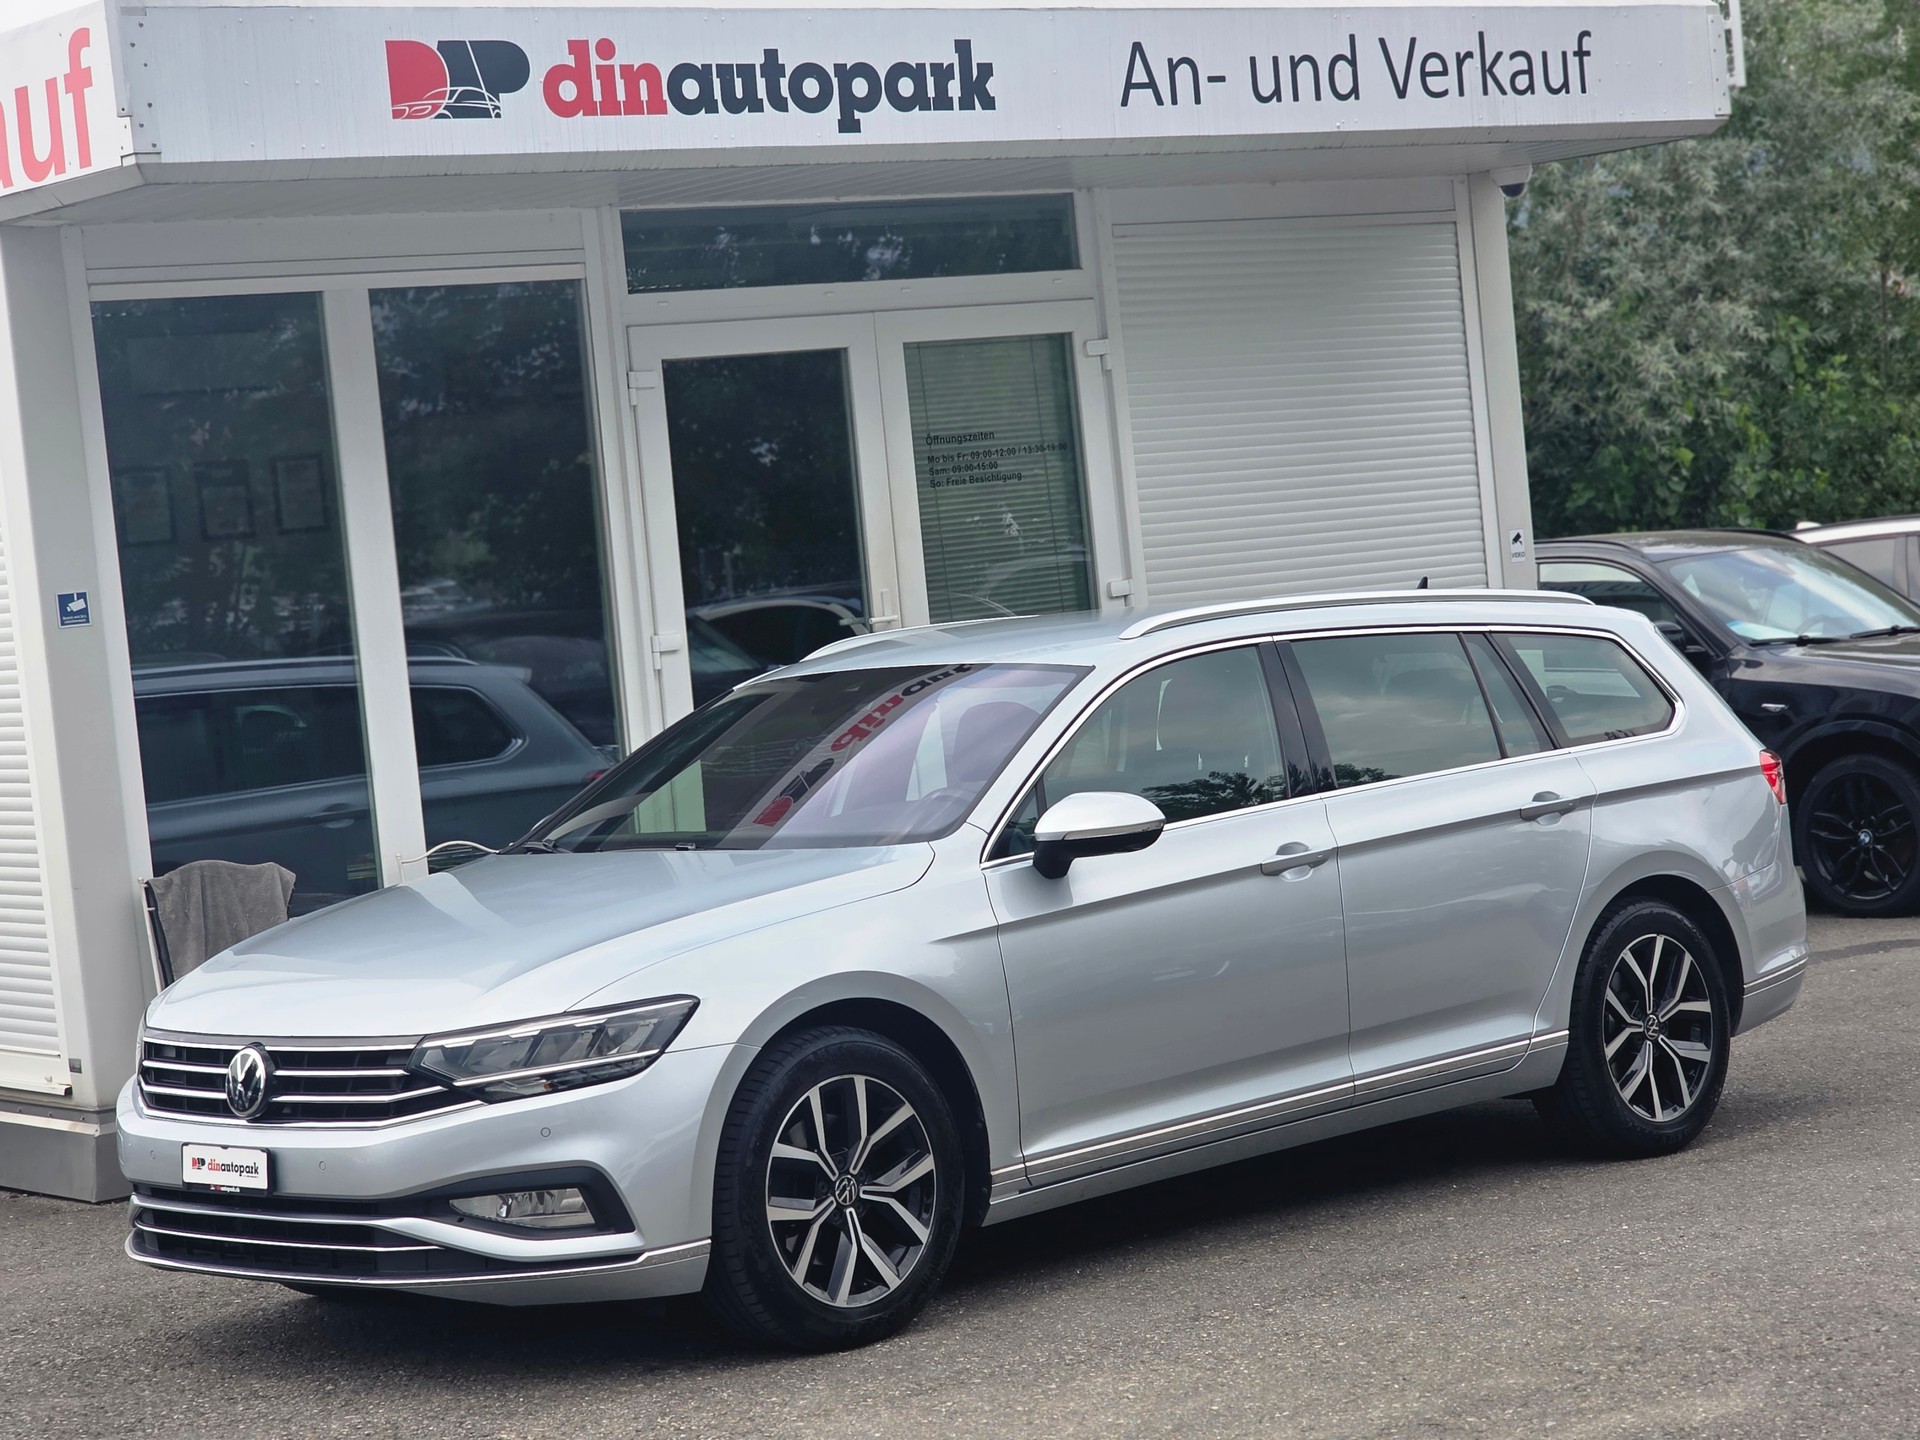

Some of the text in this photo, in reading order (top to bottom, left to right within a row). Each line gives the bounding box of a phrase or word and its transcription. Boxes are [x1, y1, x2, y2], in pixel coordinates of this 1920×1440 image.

[1120, 29, 1592, 107] An- und Verkauf
[542, 37, 996, 134] dinautopark
[926, 431, 995, 445] Öffnungszeiten
[927, 455, 940, 464] Mo
[942, 453, 955, 463] bis
[970, 447, 1016, 460] 09:00-12:00
[929, 461, 998, 476] Sam: 09:00-15:00
[930, 472, 1023, 488] So: Freie Besichtigung
[208, 1159, 259, 1177] dinautopark
